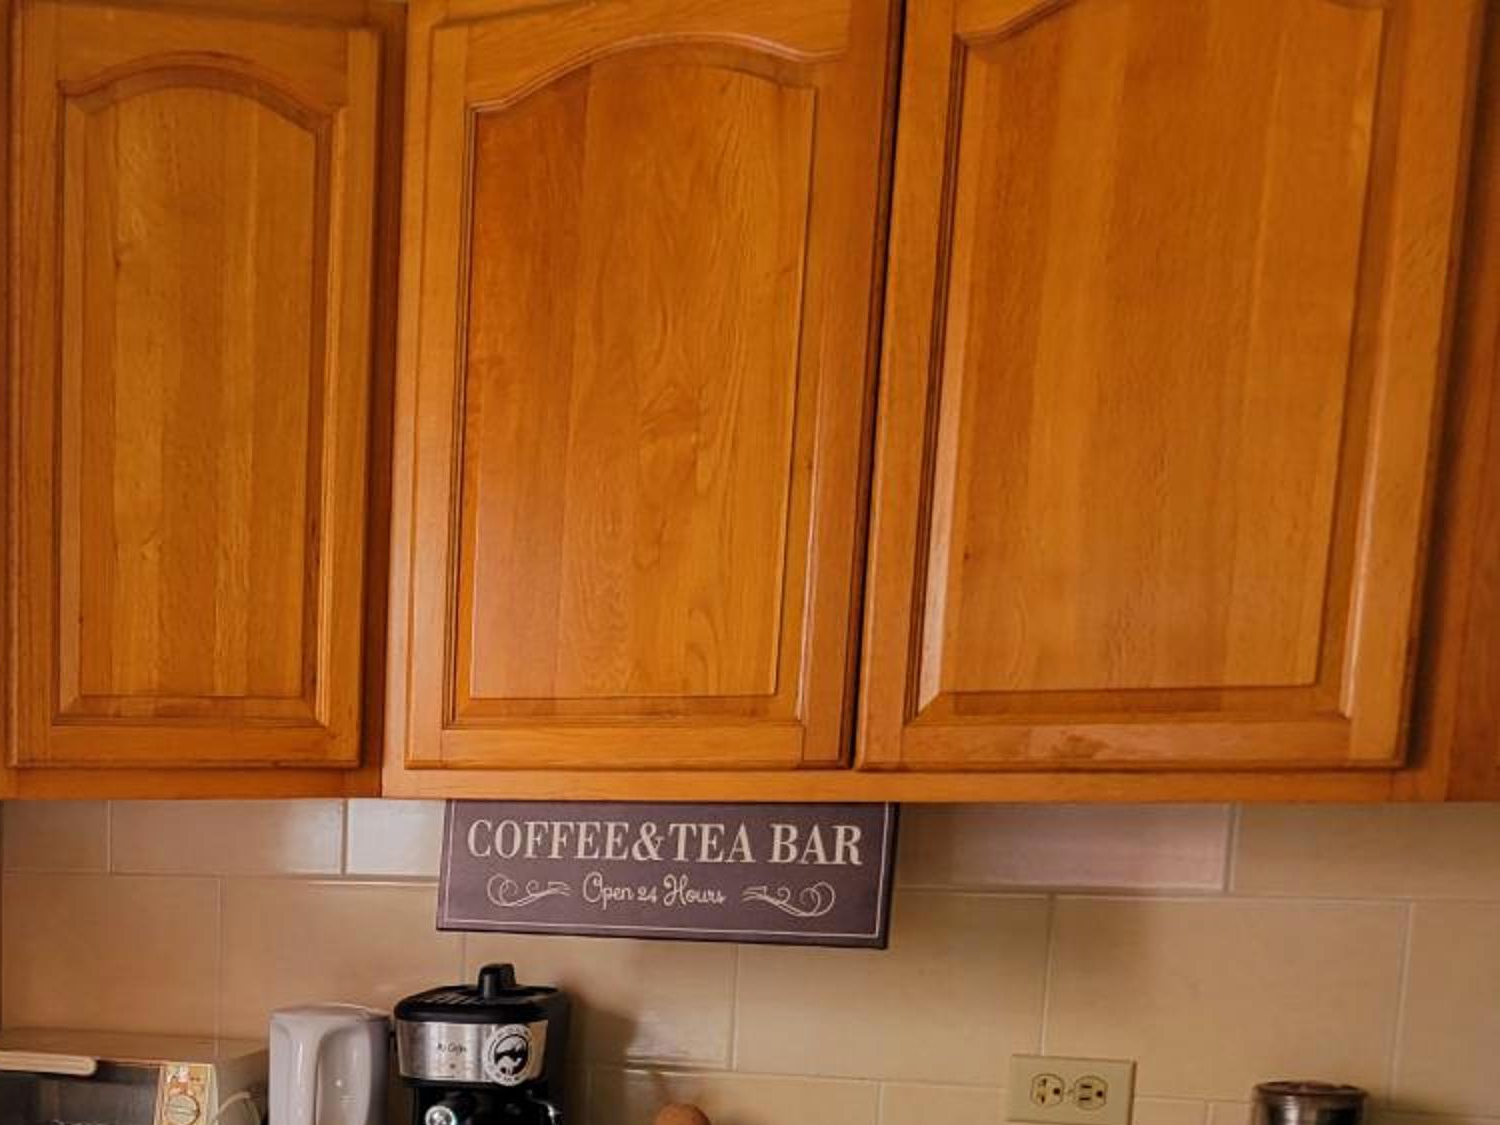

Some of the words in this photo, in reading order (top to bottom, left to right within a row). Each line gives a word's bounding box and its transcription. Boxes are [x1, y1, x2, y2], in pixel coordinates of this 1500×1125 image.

[767, 823, 863, 866] BAR
[582, 871, 634, 910] Open
[637, 886, 657, 904] 24
[663, 873, 727, 906] Hours
